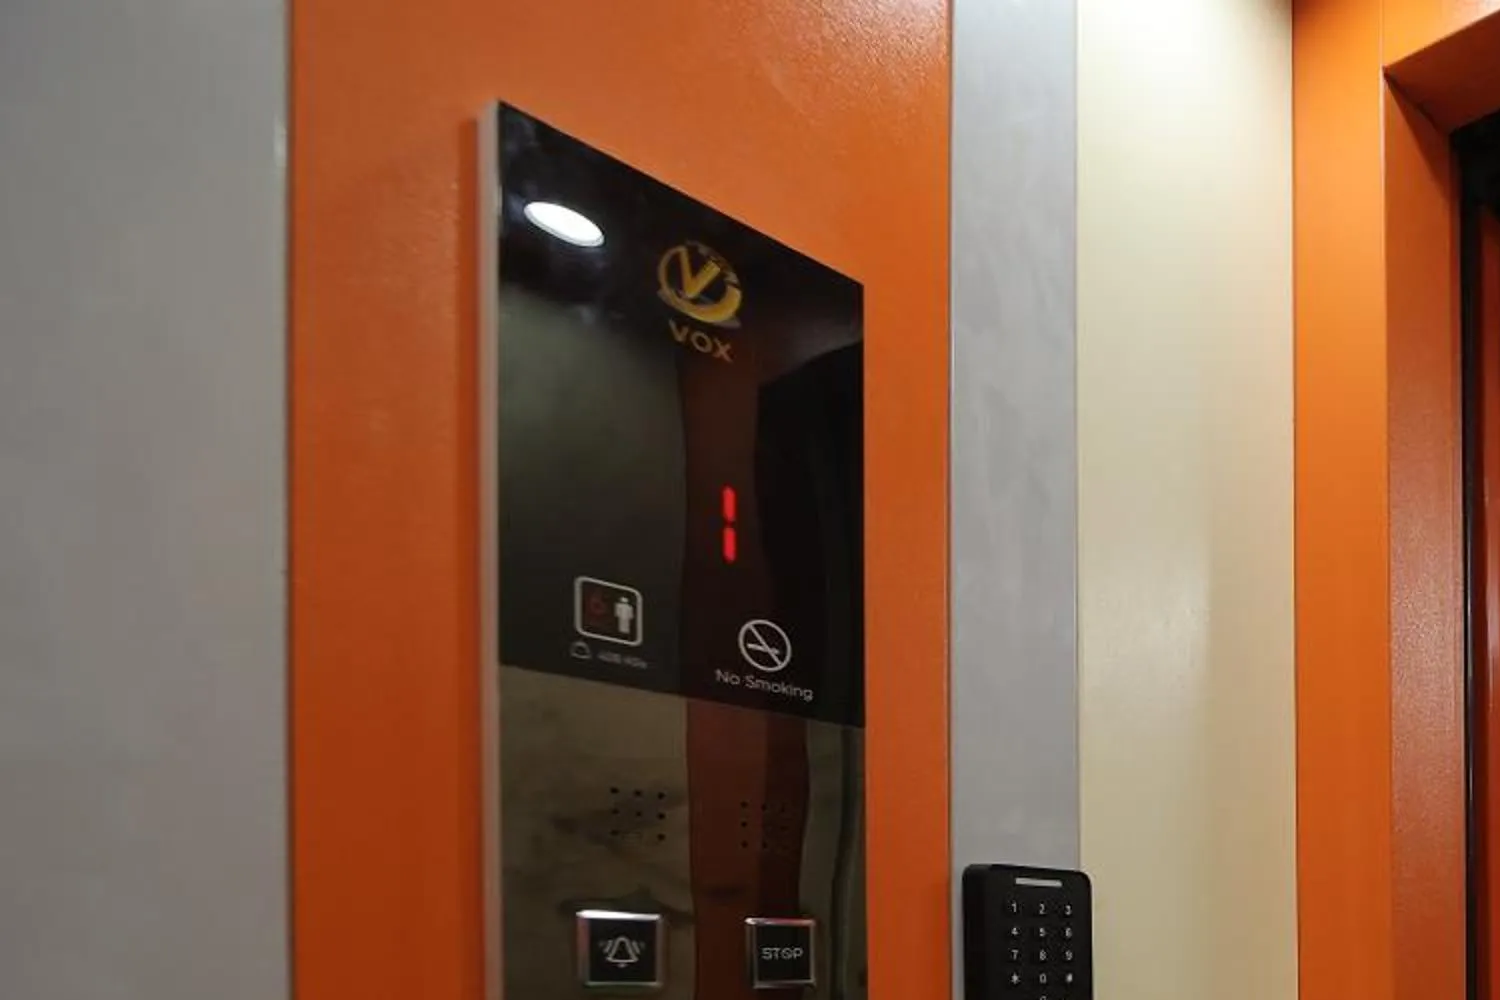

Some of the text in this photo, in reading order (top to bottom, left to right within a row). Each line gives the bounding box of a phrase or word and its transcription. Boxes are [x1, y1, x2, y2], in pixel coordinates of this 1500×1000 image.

[668, 318, 733, 363] VOX
[723, 486, 736, 563] 1
[715, 668, 815, 702] No Smoking
[1010, 902, 1073, 916] 1 2 3
[1011, 927, 1073, 938] 4 5 6
[761, 946, 804, 961] STOP
[1011, 949, 1073, 961] 7 8 9
[1039, 973, 1047, 983] 0
